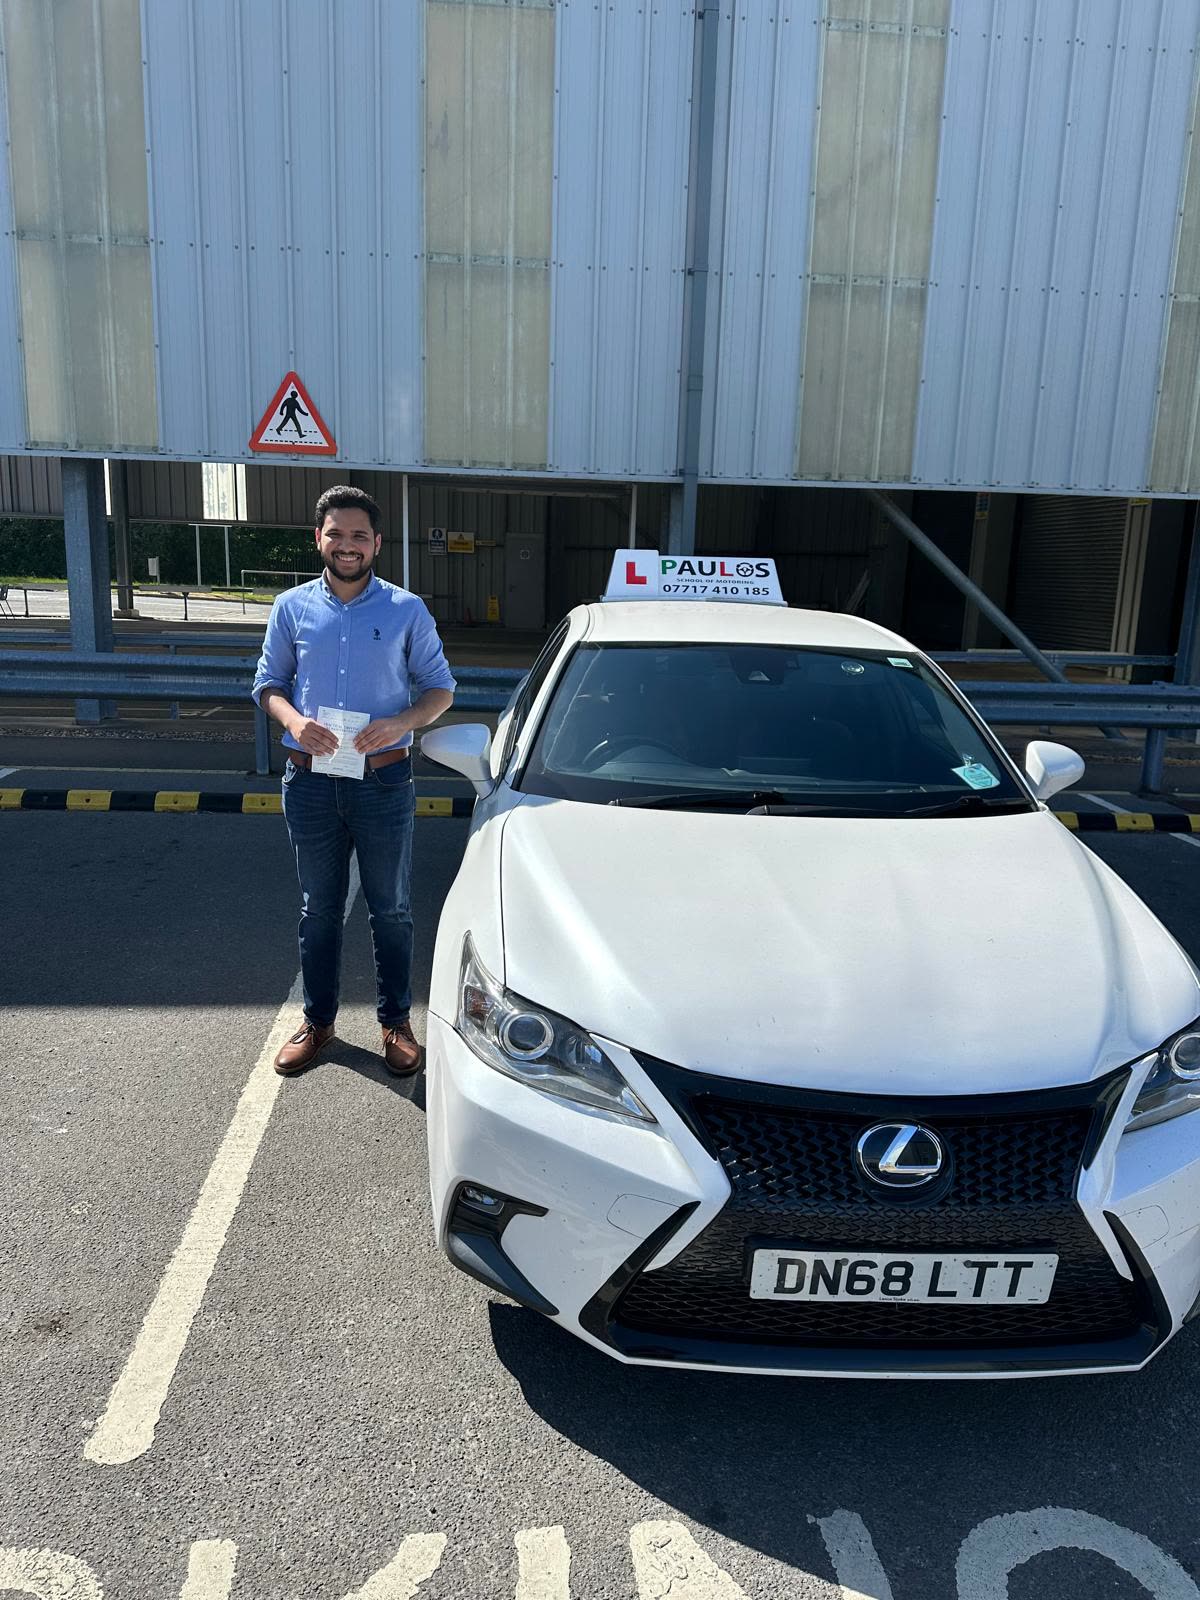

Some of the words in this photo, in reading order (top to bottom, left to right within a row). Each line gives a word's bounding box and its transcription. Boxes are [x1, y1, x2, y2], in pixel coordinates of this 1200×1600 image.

[626, 562, 647, 584] L
[661, 560, 770, 578] PAULOS
[663, 585, 708, 594] 07717
[711, 586, 739, 595] 410
[744, 587, 769, 596] 185
[774, 1257, 914, 1296] DN68
[927, 1260, 1034, 1297] LTT
